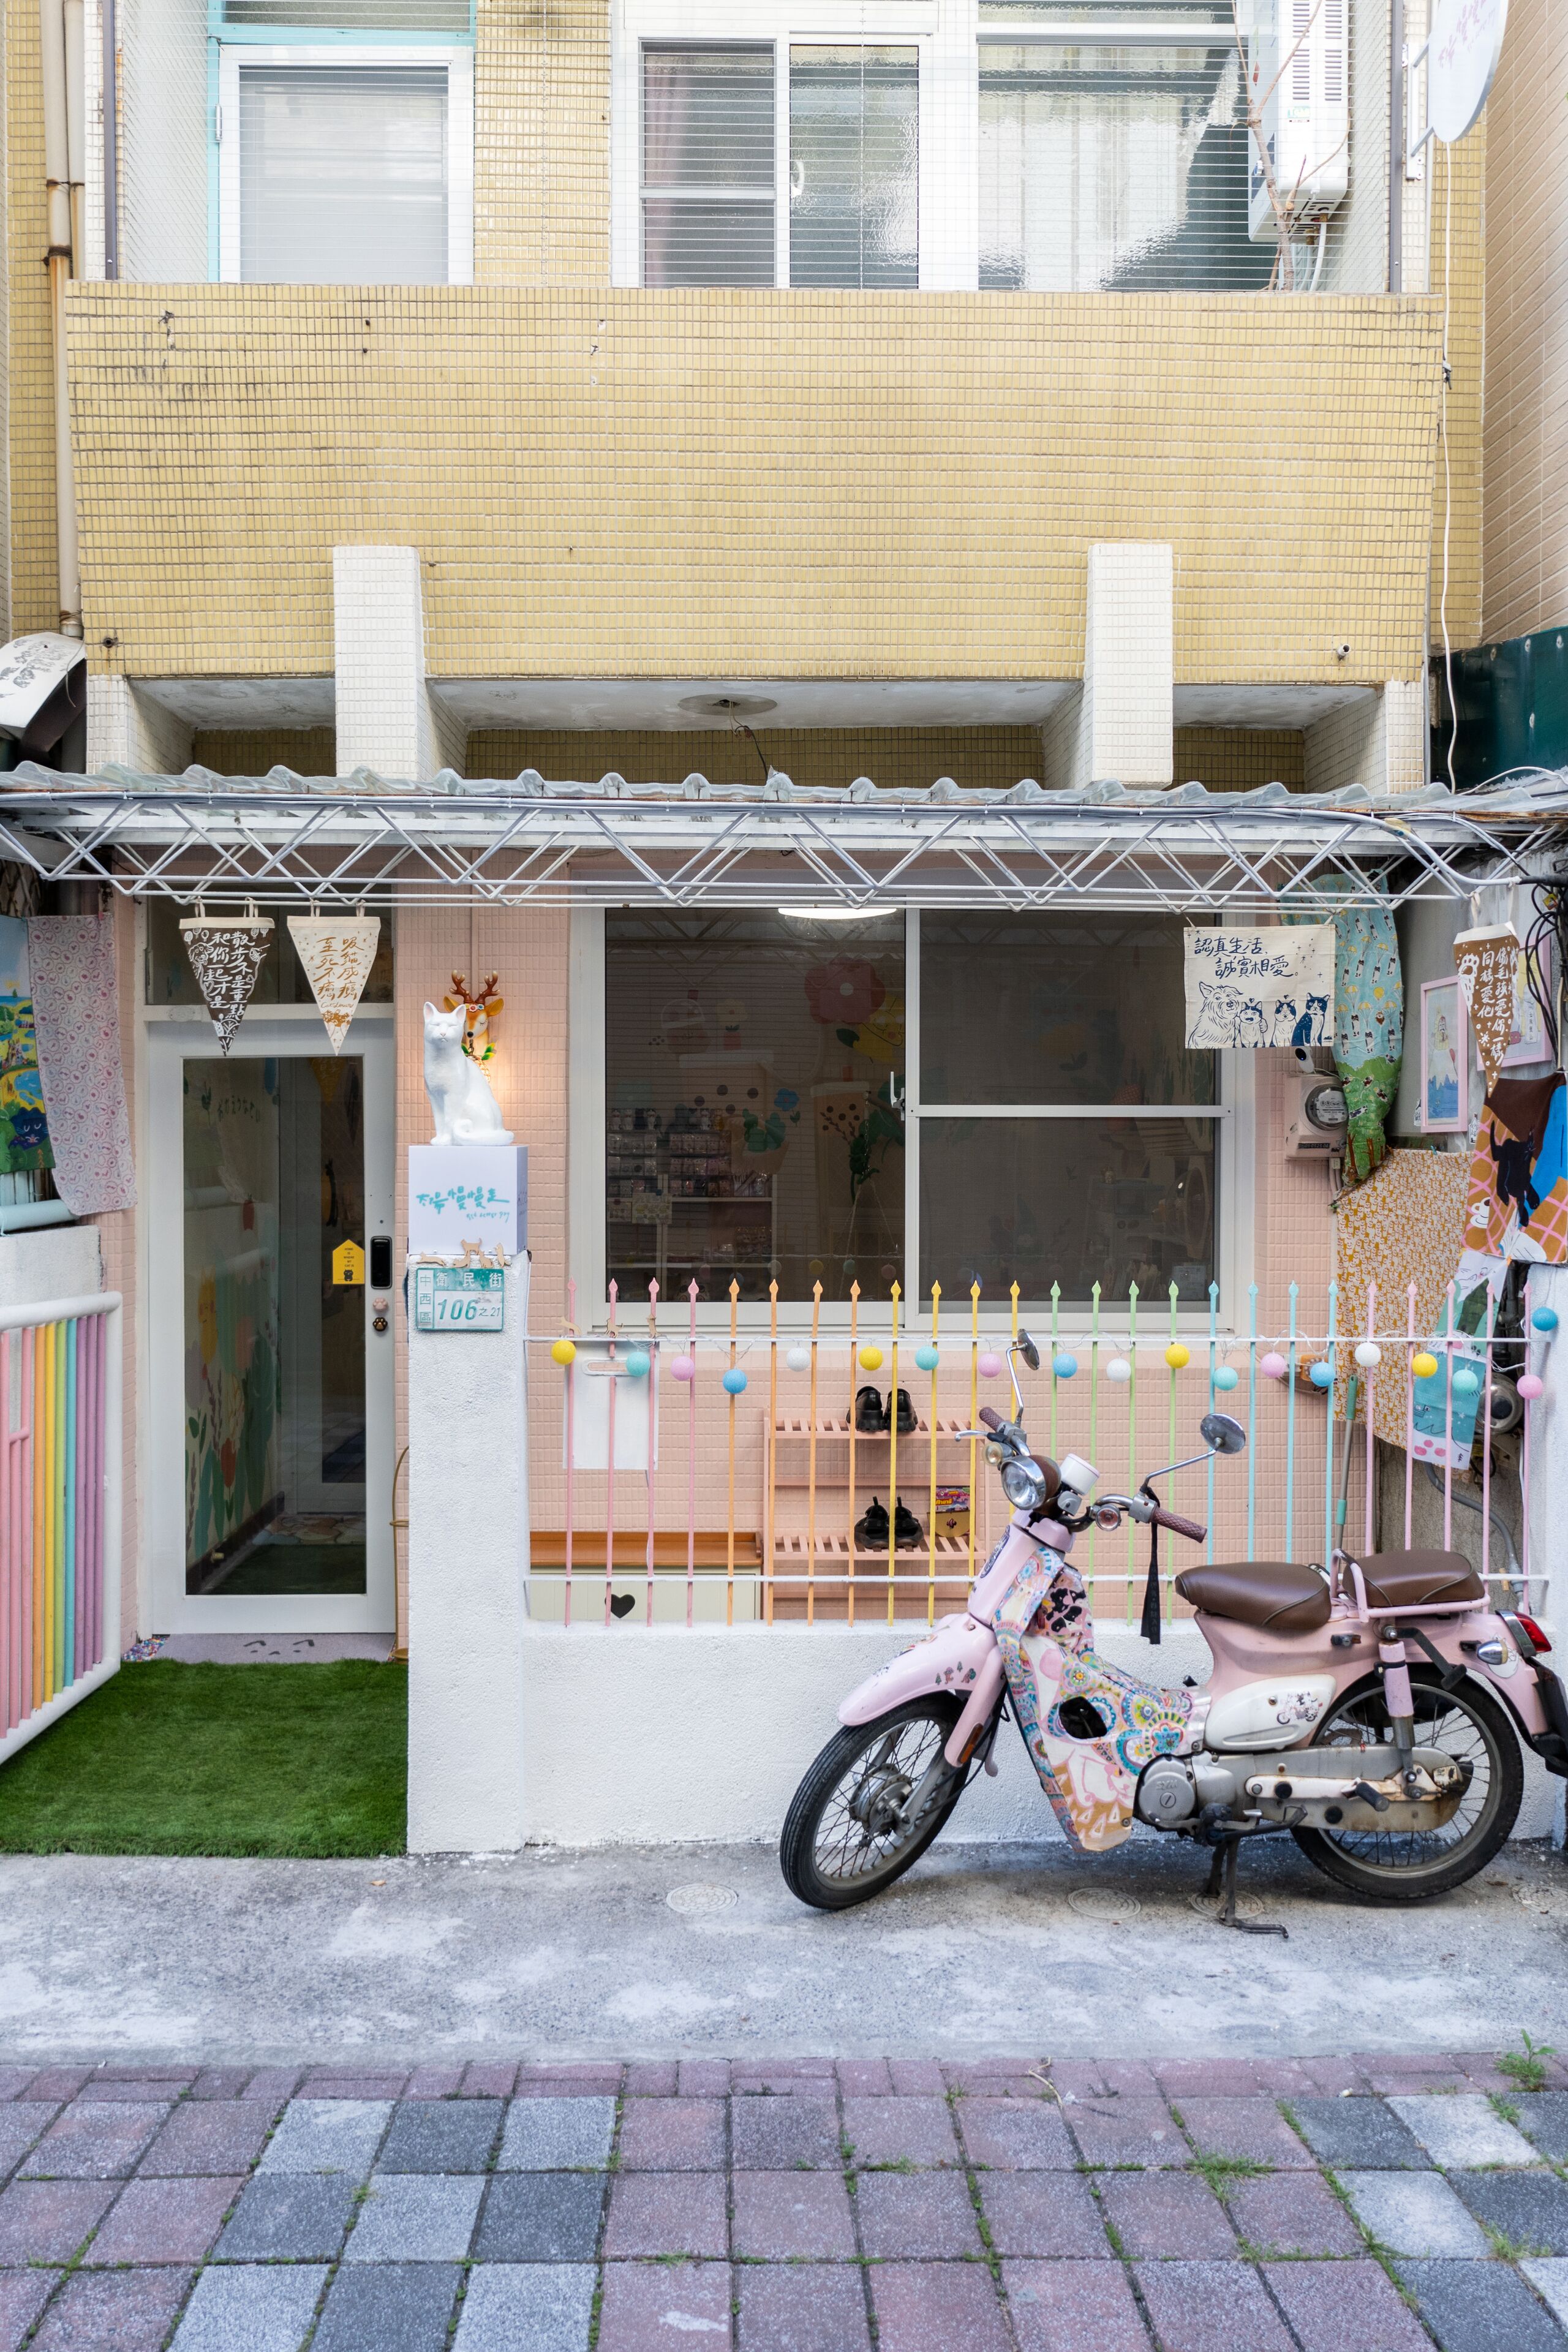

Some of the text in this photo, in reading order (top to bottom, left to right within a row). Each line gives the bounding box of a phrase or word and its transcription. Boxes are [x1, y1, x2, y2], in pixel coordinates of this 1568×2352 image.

[205, 932, 232, 1008] 和你一起才是
[228, 931, 255, 1020] 散步不是重點
[313, 937, 338, 1001] 至死不癒
[337, 937, 364, 1001] 吸貓成癮
[1477, 951, 1495, 1018] 同樣愛他
[1490, 947, 1510, 1066] 像毛孩愛你一樣
[416, 1186, 510, 1215] 太陽慢慢走
[420, 1275, 431, 1324] 中西區
[435, 1272, 502, 1288] 衛民街
